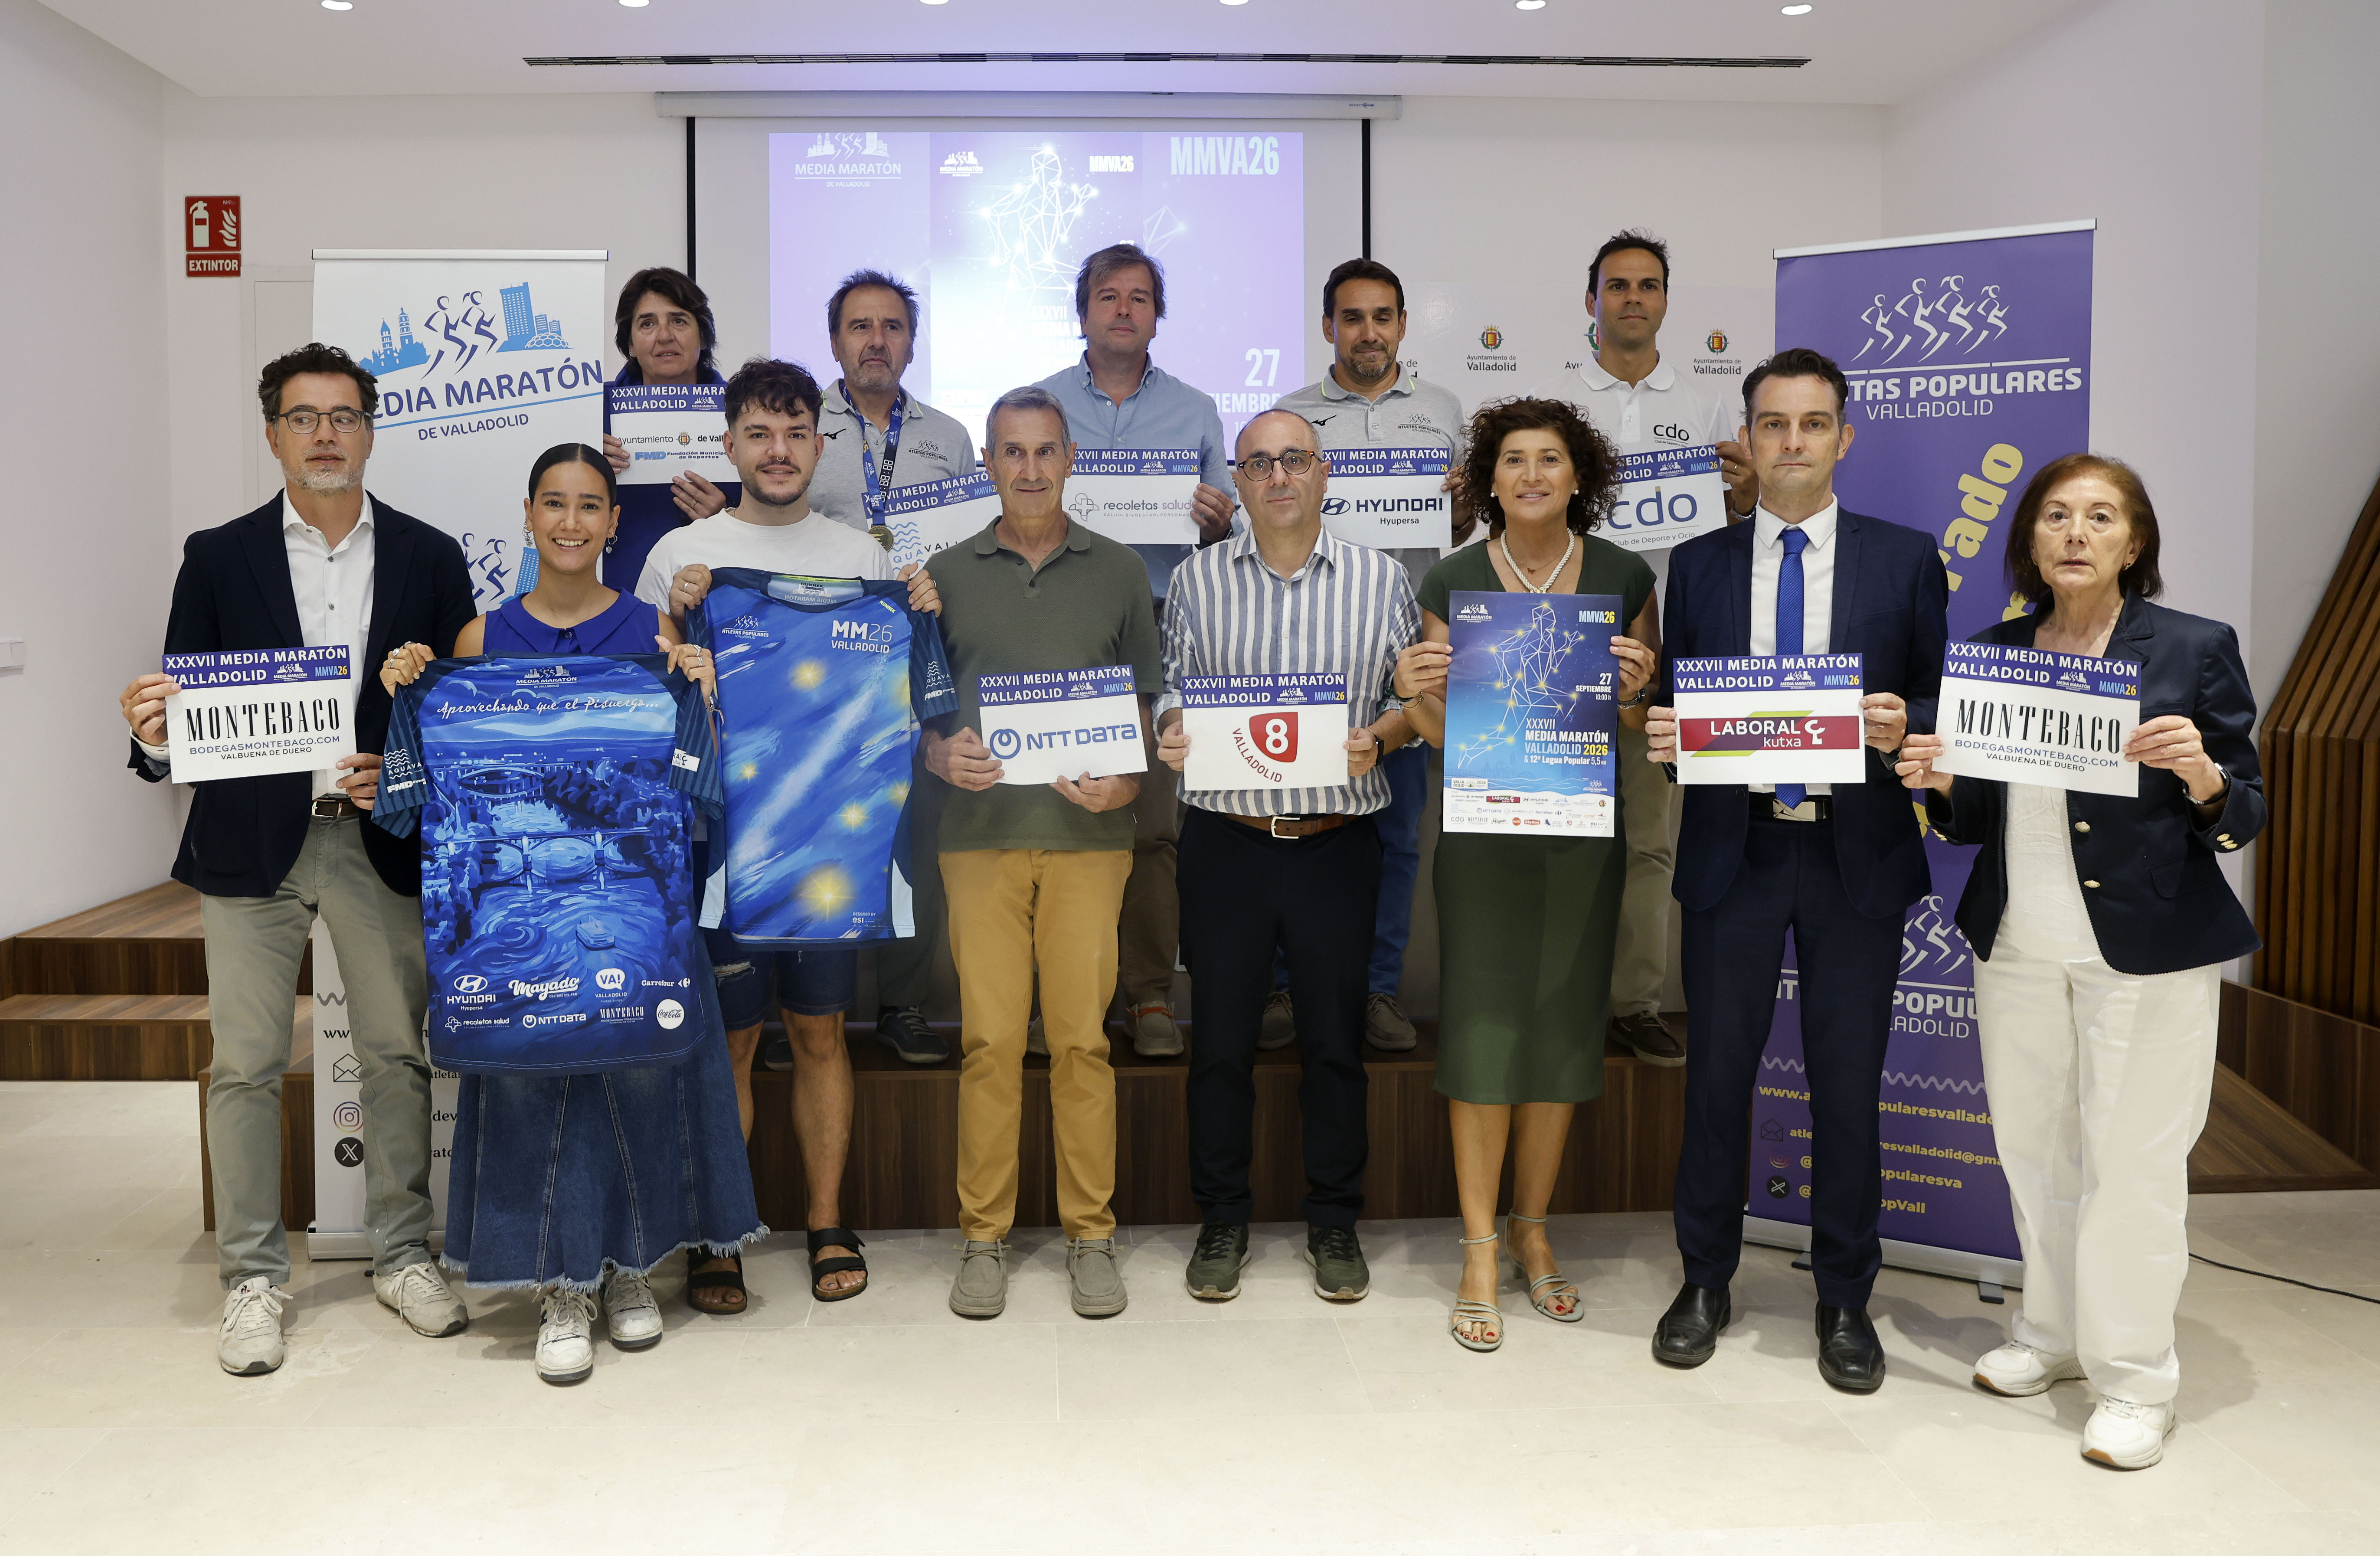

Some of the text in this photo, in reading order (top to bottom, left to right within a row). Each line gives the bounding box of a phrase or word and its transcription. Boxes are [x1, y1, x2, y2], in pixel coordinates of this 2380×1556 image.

[1171, 136, 1279, 175] MMVA26
[795, 160, 901, 175] MEDIA MARATÓN
[1089, 156, 1134, 172] MMVA26
[189, 259, 239, 271] EXTINTOR
[1030, 305, 1067, 320] XXXVII
[1245, 348, 1280, 386] 27
[1406, 359, 1417, 367] de
[1467, 362, 1516, 371] Valladolid
[1693, 366, 1741, 375] Valladolid
[373, 357, 603, 419] EDIA MARATÓN
[1910, 368, 2082, 399] POPULARES
[612, 386, 689, 398] XXXVII MEDIA
[612, 399, 687, 411] VALLADOLID
[1866, 399, 1993, 420] VALLADOLID
[418, 414, 529, 440] DE VALLADOLID
[1653, 423, 1689, 441] cdo
[635, 451, 666, 460] FMD
[926, 452, 948, 461] POPULARES
[1102, 450, 1198, 460] MEDIA MARATÓN
[1350, 448, 1448, 460] MEDIA MARATÓN
[1622, 446, 1716, 467] EDIA MARATÓN
[1328, 464, 1384, 474] LADOLID
[1422, 464, 1448, 472] MMVA26
[1691, 461, 1718, 472] MMVA26
[864, 471, 989, 503] XVII MEDIA MARATÓ
[867, 497, 938, 515] VLADOLID
[1104, 499, 1193, 510] recoletas salud
[1357, 498, 1443, 512] HYUNDAI
[1607, 486, 1697, 530] cdo
[1641, 535, 1670, 543] Deporte
[879, 600, 896, 614] RUNNEK
[1579, 611, 1615, 624] MMVA26
[832, 620, 892, 642] MM26
[831, 640, 889, 653] VALLADOLID
[166, 647, 347, 669] XXXVII MEDIA MARATÓN
[1676, 654, 1859, 672] XXXVII MEDIA MARATÓN
[1948, 643, 2137, 677] XXXVII MEDIA MARATÓN
[315, 665, 347, 677] MMVA26
[980, 666, 1131, 687] XXXVII MEDIA MARATÓN
[1948, 661, 2050, 683] VALLADOLID
[1185, 673, 1344, 689] XXXVII MEDIA MARATÓN
[1599, 673, 1612, 685] 27
[1677, 676, 1773, 689] VALLADOLID
[1824, 675, 1860, 686] MMVA26
[1104, 682, 1133, 693] MMVA26
[1575, 685, 1612, 693] SEPTIEMBRE
[2099, 681, 2137, 696] MMVA26
[925, 690, 943, 701] FMD
[981, 688, 1062, 703] VALLADOLID
[1185, 692, 1271, 705] VALLADOLID
[1314, 691, 1345, 701] MMVA26
[437, 699, 530, 719] Aprovechando
[536, 702, 559, 715] que
[565, 700, 579, 710] el
[185, 698, 340, 742] MONTEBACO
[1526, 718, 1556, 730] XXXVII
[1955, 699, 2120, 754] MONTEBACO
[1710, 719, 1801, 736] LABORAL
[1027, 731, 1071, 750] NTT
[1265, 718, 1289, 755] 8
[1525, 730, 1609, 743] MEDIA MARATÓN
[1764, 737, 1801, 748] kutxa
[190, 736, 340, 755] BODEGASMONTEBACO.COM
[1524, 742, 1608, 756] VALLADOLID 2026
[221, 752, 267, 760] VALBUENA
[1232, 728, 1282, 783] VALLADOLID
[1955, 739, 2118, 768] BODEGASMONTEBACO.COM
[1524, 755, 1529, 763] &
[1542, 755, 1563, 765] Legua
[1563, 756, 1590, 766] Popular
[1591, 757, 1601, 766] 5,5
[1986, 753, 2037, 765] VALBUENA
[2054, 762, 2085, 772] DUERO
[387, 780, 413, 793] FMD
[600, 974, 621, 984] VA!
[508, 977, 580, 1001] Mayado
[447, 994, 496, 1004] HYUNDAI
[600, 1006, 644, 1019] MONTEBACO
[658, 1009, 683, 1018] Coca-Cola
[538, 1016, 558, 1025] NTT
